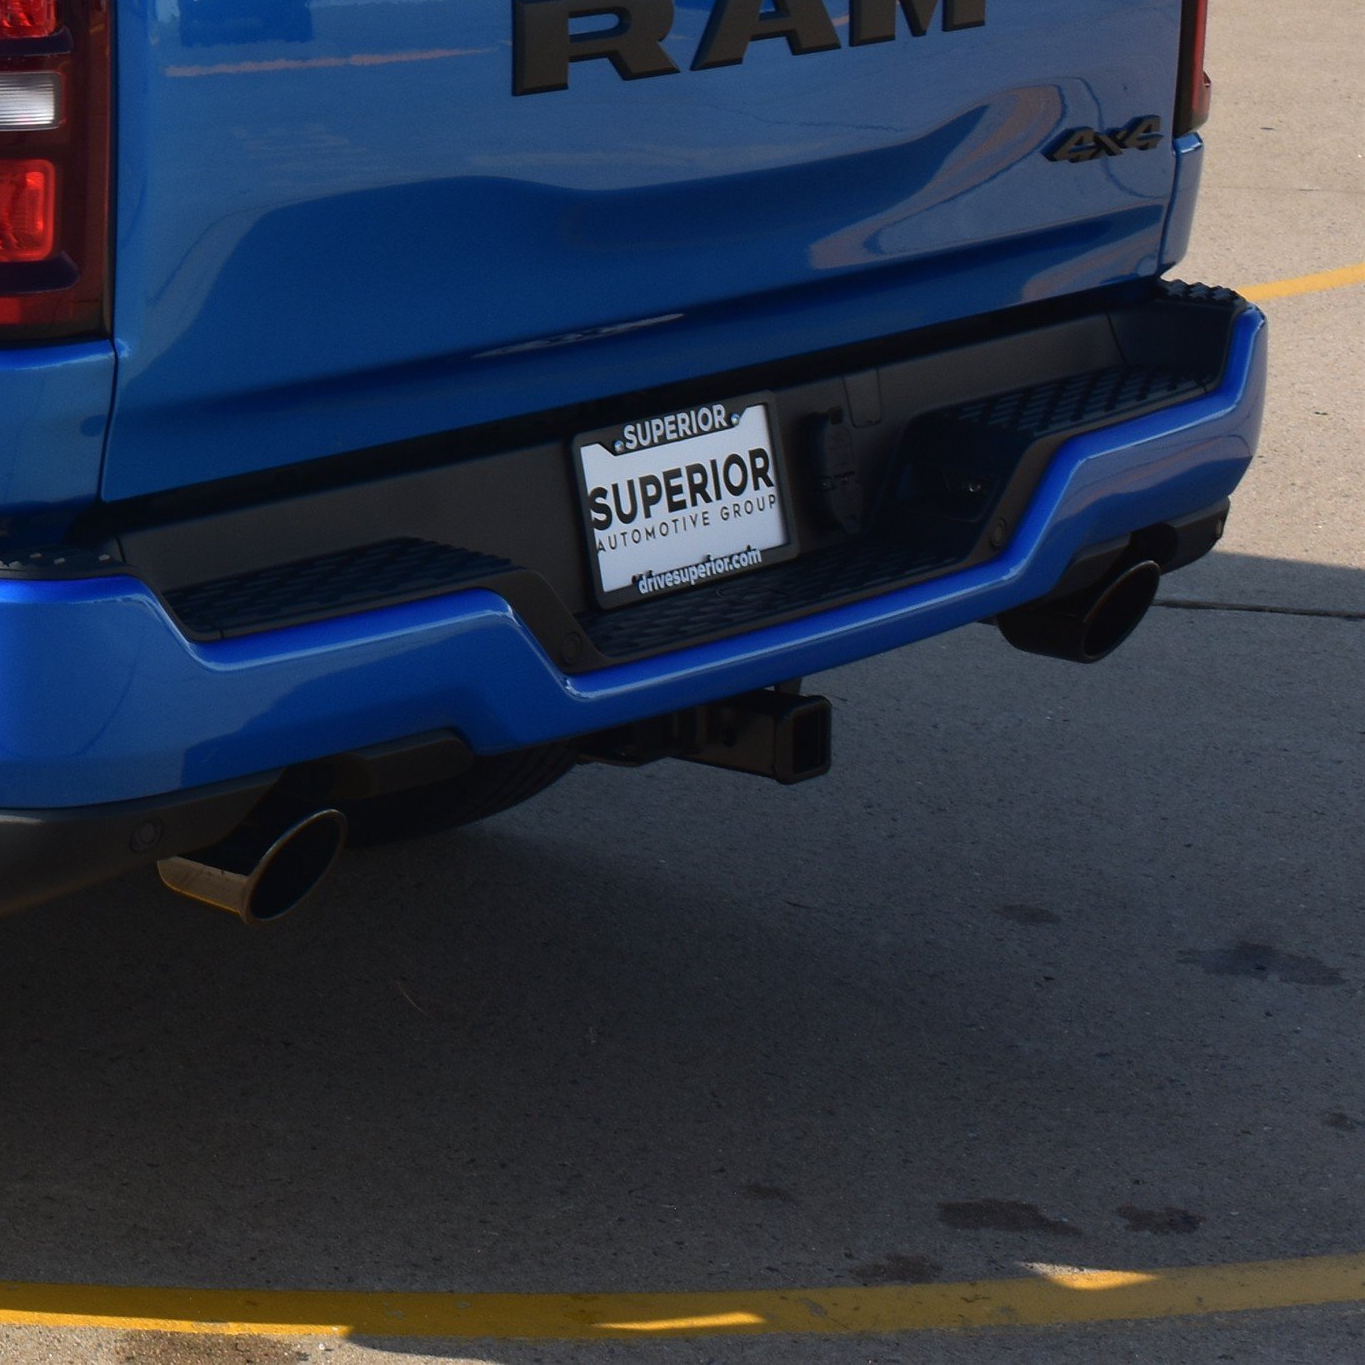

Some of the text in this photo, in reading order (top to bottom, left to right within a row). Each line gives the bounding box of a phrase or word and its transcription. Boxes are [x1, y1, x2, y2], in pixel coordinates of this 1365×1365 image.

[1040, 114, 1164, 163] 4x4
[623, 404, 729, 450] SUPERIOR
[588, 447, 775, 531] SUPERIOR
[596, 494, 777, 554] AUTOMOTIVE GROUP
[638, 546, 763, 594] drivesuperior.com
